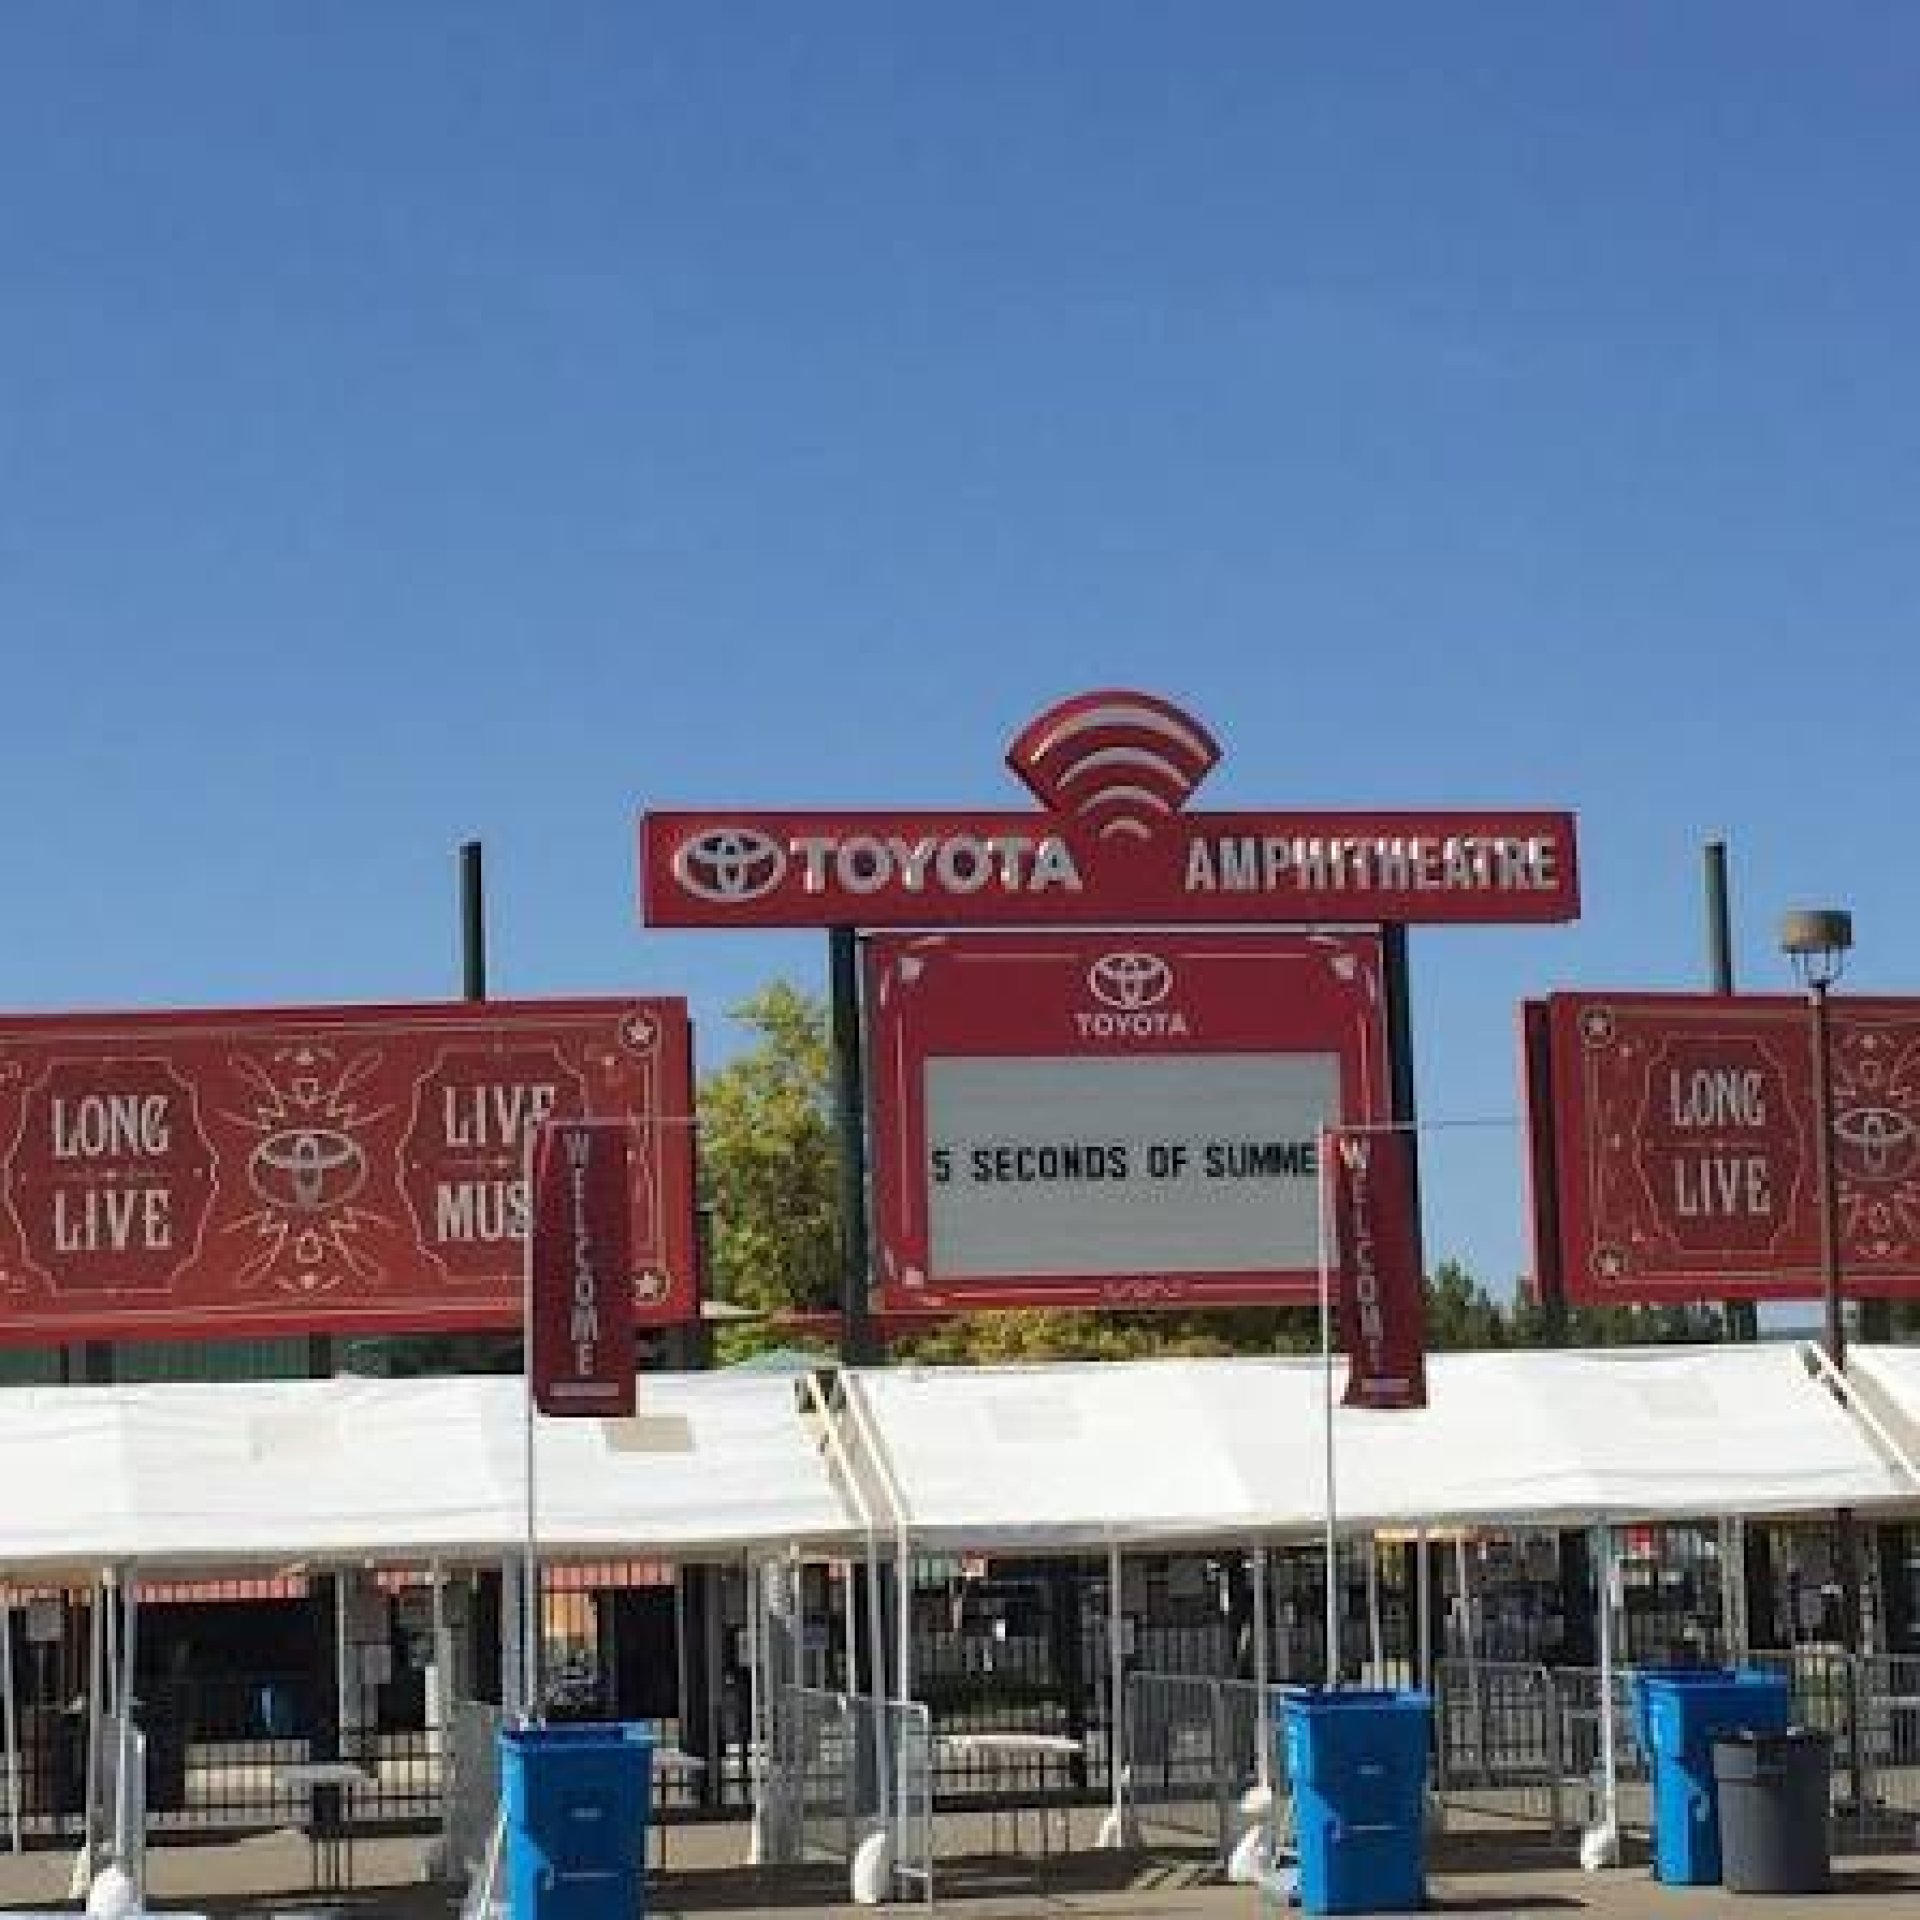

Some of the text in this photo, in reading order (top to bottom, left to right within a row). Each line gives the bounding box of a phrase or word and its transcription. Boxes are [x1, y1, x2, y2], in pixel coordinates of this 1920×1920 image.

[790, 836, 1560, 894] TOYOTA AMPHITHEATRE
[1075, 1012, 1190, 1037] TOYOTA
[52, 1096, 169, 1158] LONG
[1670, 1069, 1765, 1127] LONG
[931, 1141, 1319, 1183] 5 SECONDS OF SUMME
[1674, 1158, 1771, 1217] LIVE
[54, 1189, 172, 1252] LIVE
[436, 1179, 530, 1242] MUS
[563, 1132, 599, 1377] WELCOME
